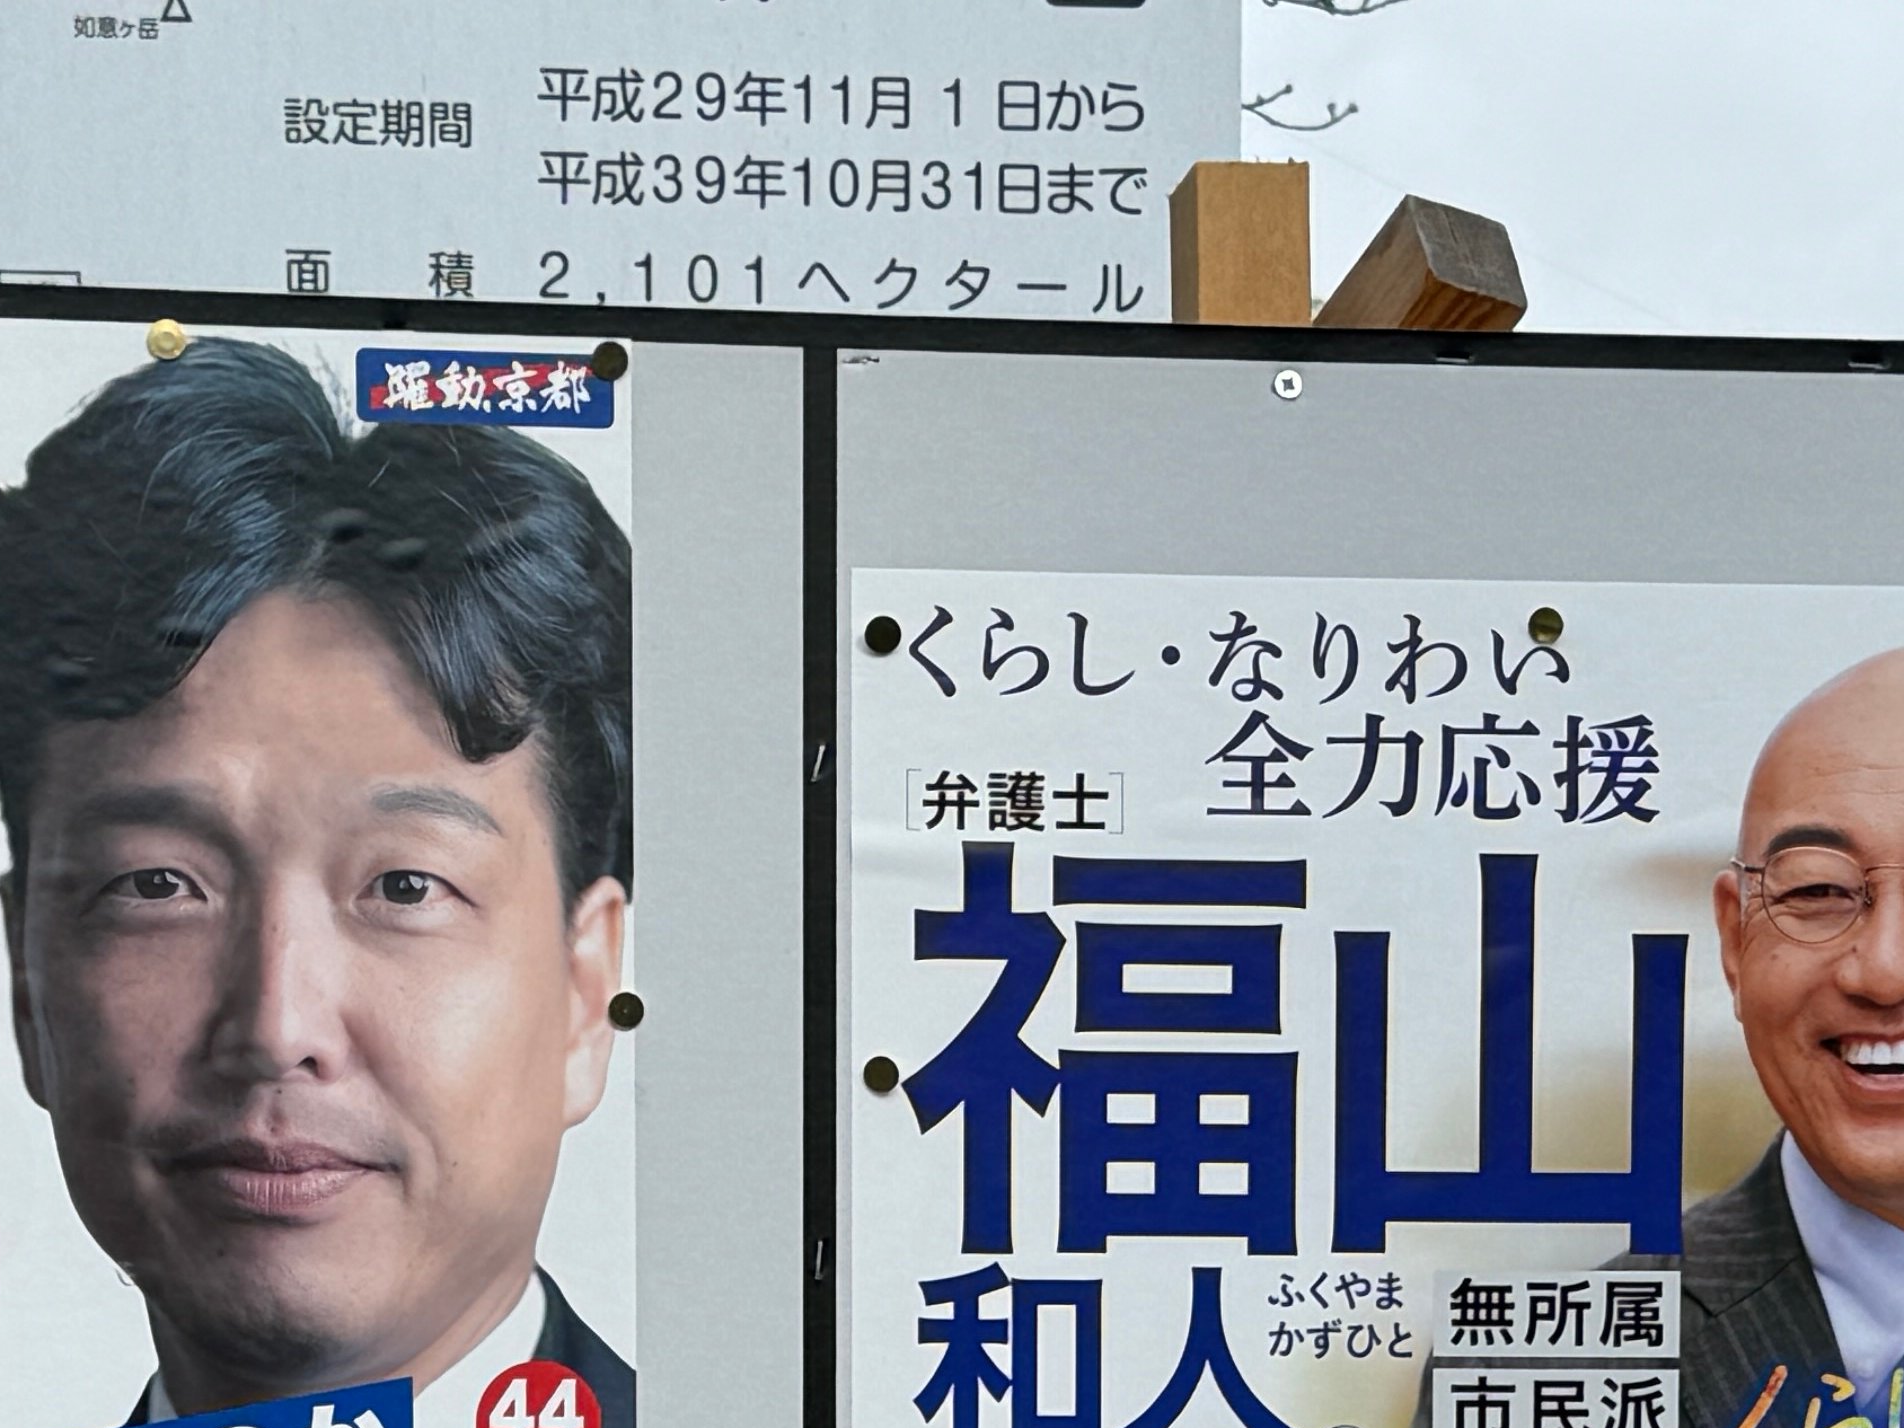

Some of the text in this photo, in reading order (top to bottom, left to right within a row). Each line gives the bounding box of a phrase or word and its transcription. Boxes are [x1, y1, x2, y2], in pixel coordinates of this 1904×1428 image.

[282, 97, 475, 150] 設定期間
[536, 149, 1151, 219] 平成39年10月31日まで
[907, 604, 1571, 705] くらし・なりわい
[1204, 709, 1662, 825] 全力応援
[900, 840, 1690, 1256] 福山
[1266, 1271, 1404, 1311] ふくやま
[1449, 1277, 1666, 1348] 無所属
[1267, 1319, 1415, 1360] かずひと
